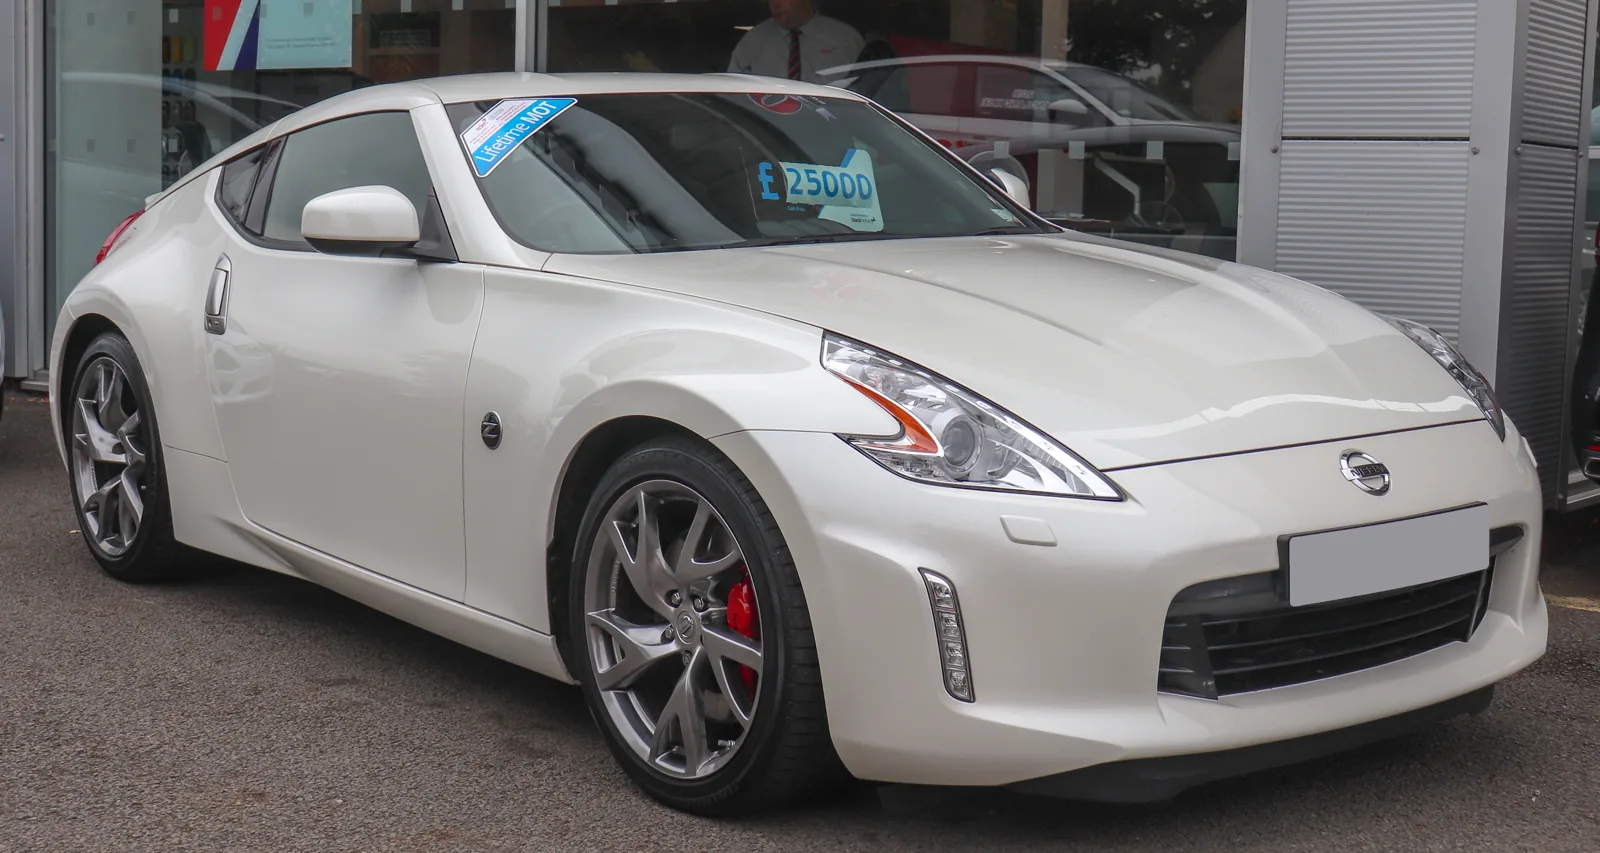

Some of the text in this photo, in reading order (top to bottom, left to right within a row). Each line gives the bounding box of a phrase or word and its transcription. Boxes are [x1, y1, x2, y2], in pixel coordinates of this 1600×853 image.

[475, 123, 531, 162] Lifetime
[520, 100, 557, 124] MOT
[758, 162, 872, 200] £ 25000
[1350, 464, 1387, 477] NISSAN
